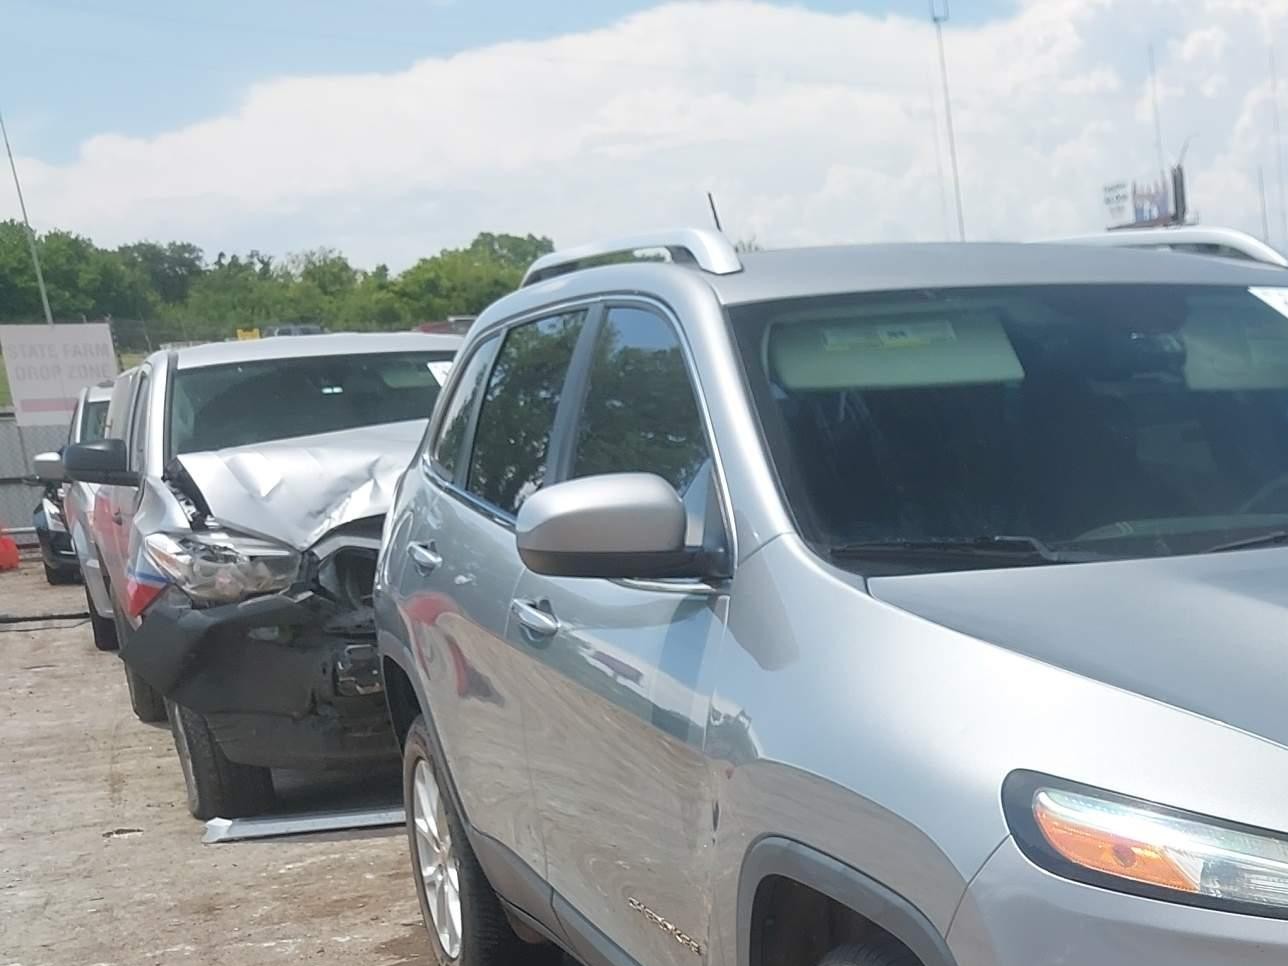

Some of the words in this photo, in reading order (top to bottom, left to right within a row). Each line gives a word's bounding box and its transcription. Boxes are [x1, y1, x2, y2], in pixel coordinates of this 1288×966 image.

[7, 343, 58, 360] STATE
[63, 342, 110, 358] FARM
[15, 364, 62, 381] DROP
[68, 363, 112, 379] ZONE
